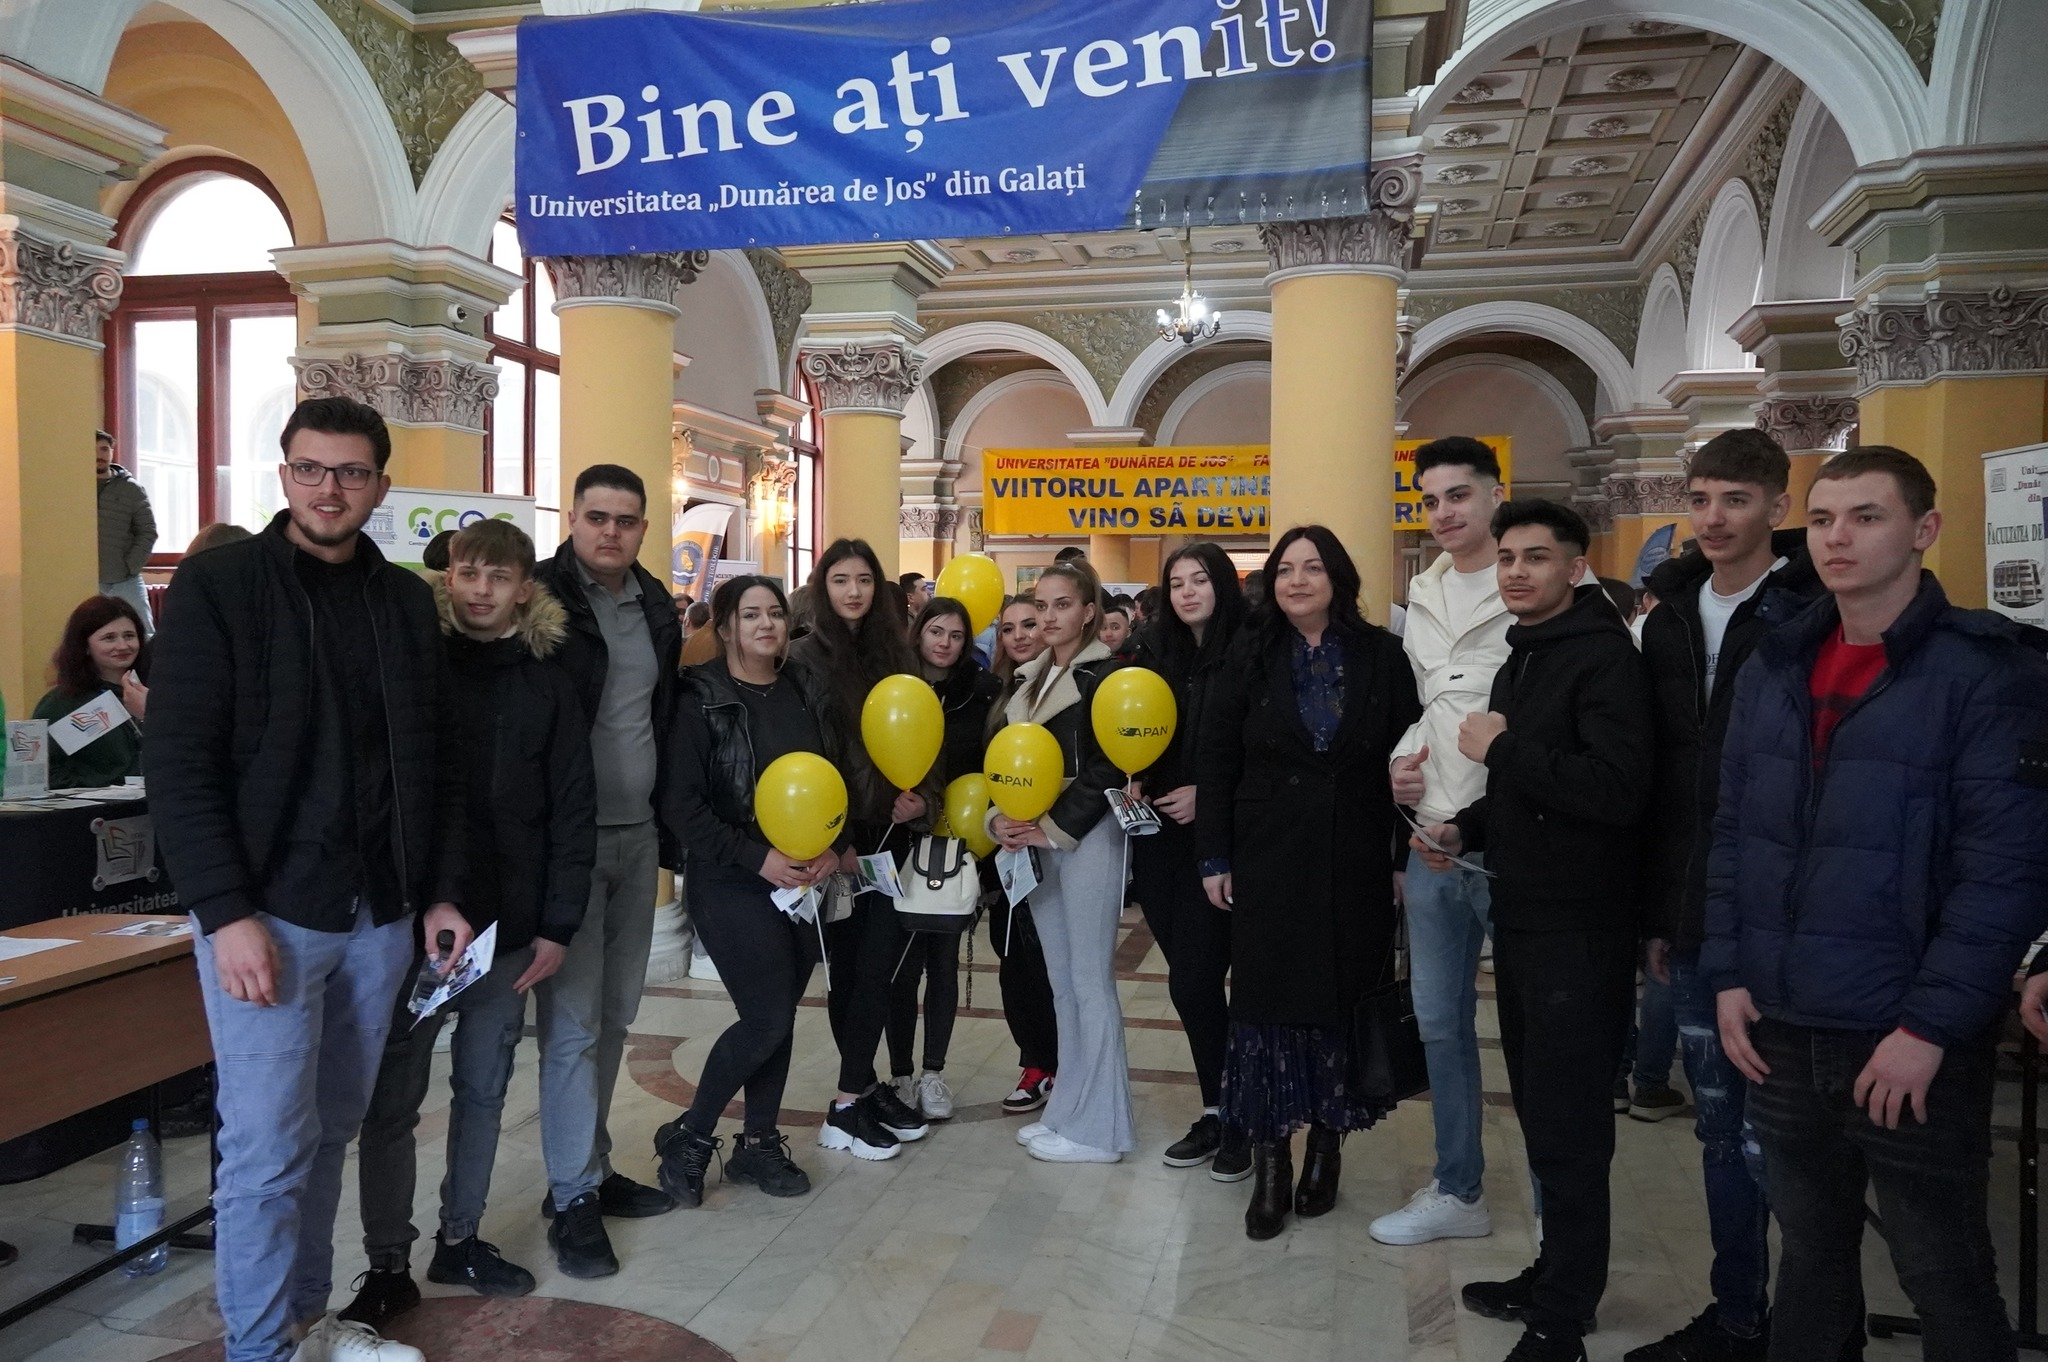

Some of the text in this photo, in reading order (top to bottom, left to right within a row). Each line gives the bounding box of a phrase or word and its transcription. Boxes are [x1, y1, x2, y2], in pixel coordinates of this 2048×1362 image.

[562, 0, 1335, 175] Bine ați venit!
[529, 162, 1086, 217] Universitatea „Dunărea de Jos” din Galați
[996, 457, 1100, 470] UNIVERSITATEA
[1178, 456, 1197, 468] DE
[991, 477, 1124, 498] VIITORUL
[1068, 507, 1140, 528] VINO
[1197, 505, 1270, 527] DEVI
[1394, 502, 1422, 523] R!
[62, 891, 179, 917] iversitatea
